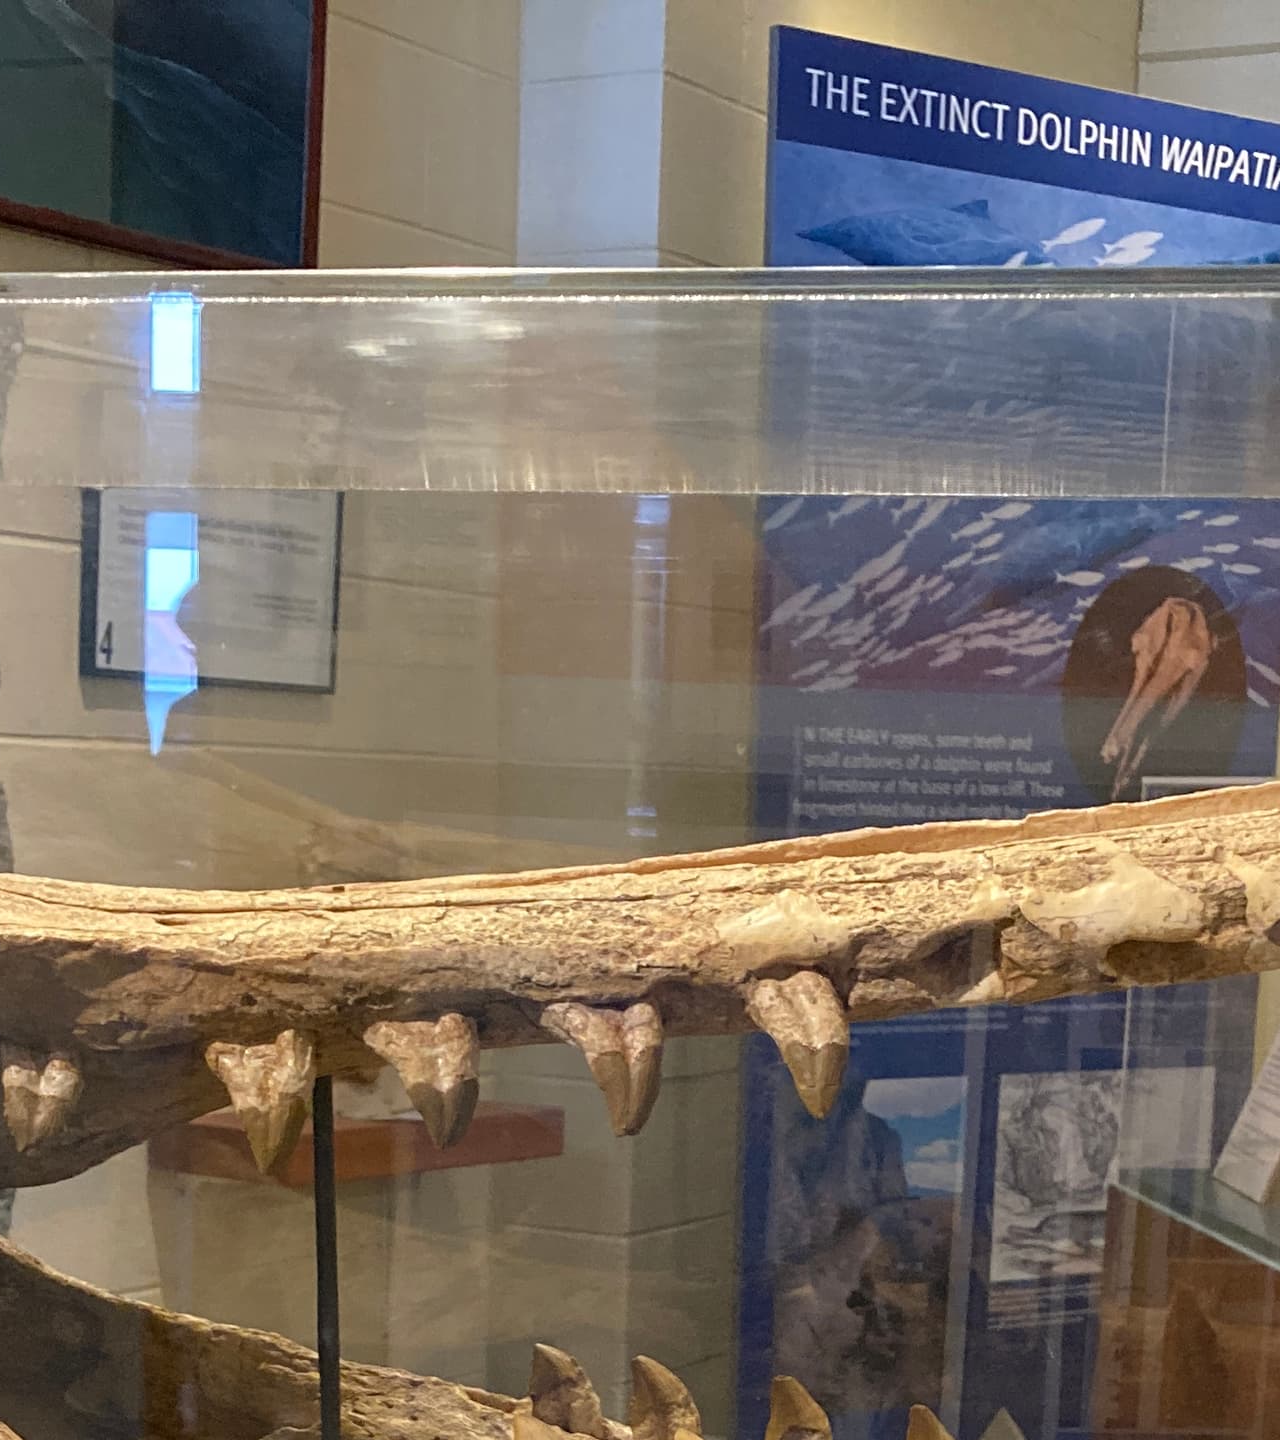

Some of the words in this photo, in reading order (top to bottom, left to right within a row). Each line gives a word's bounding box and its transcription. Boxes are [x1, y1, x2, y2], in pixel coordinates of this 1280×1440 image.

[806, 68, 869, 118] THE
[880, 82, 1010, 141] EXTINCT
[1016, 108, 1152, 168] DOLPHIN
